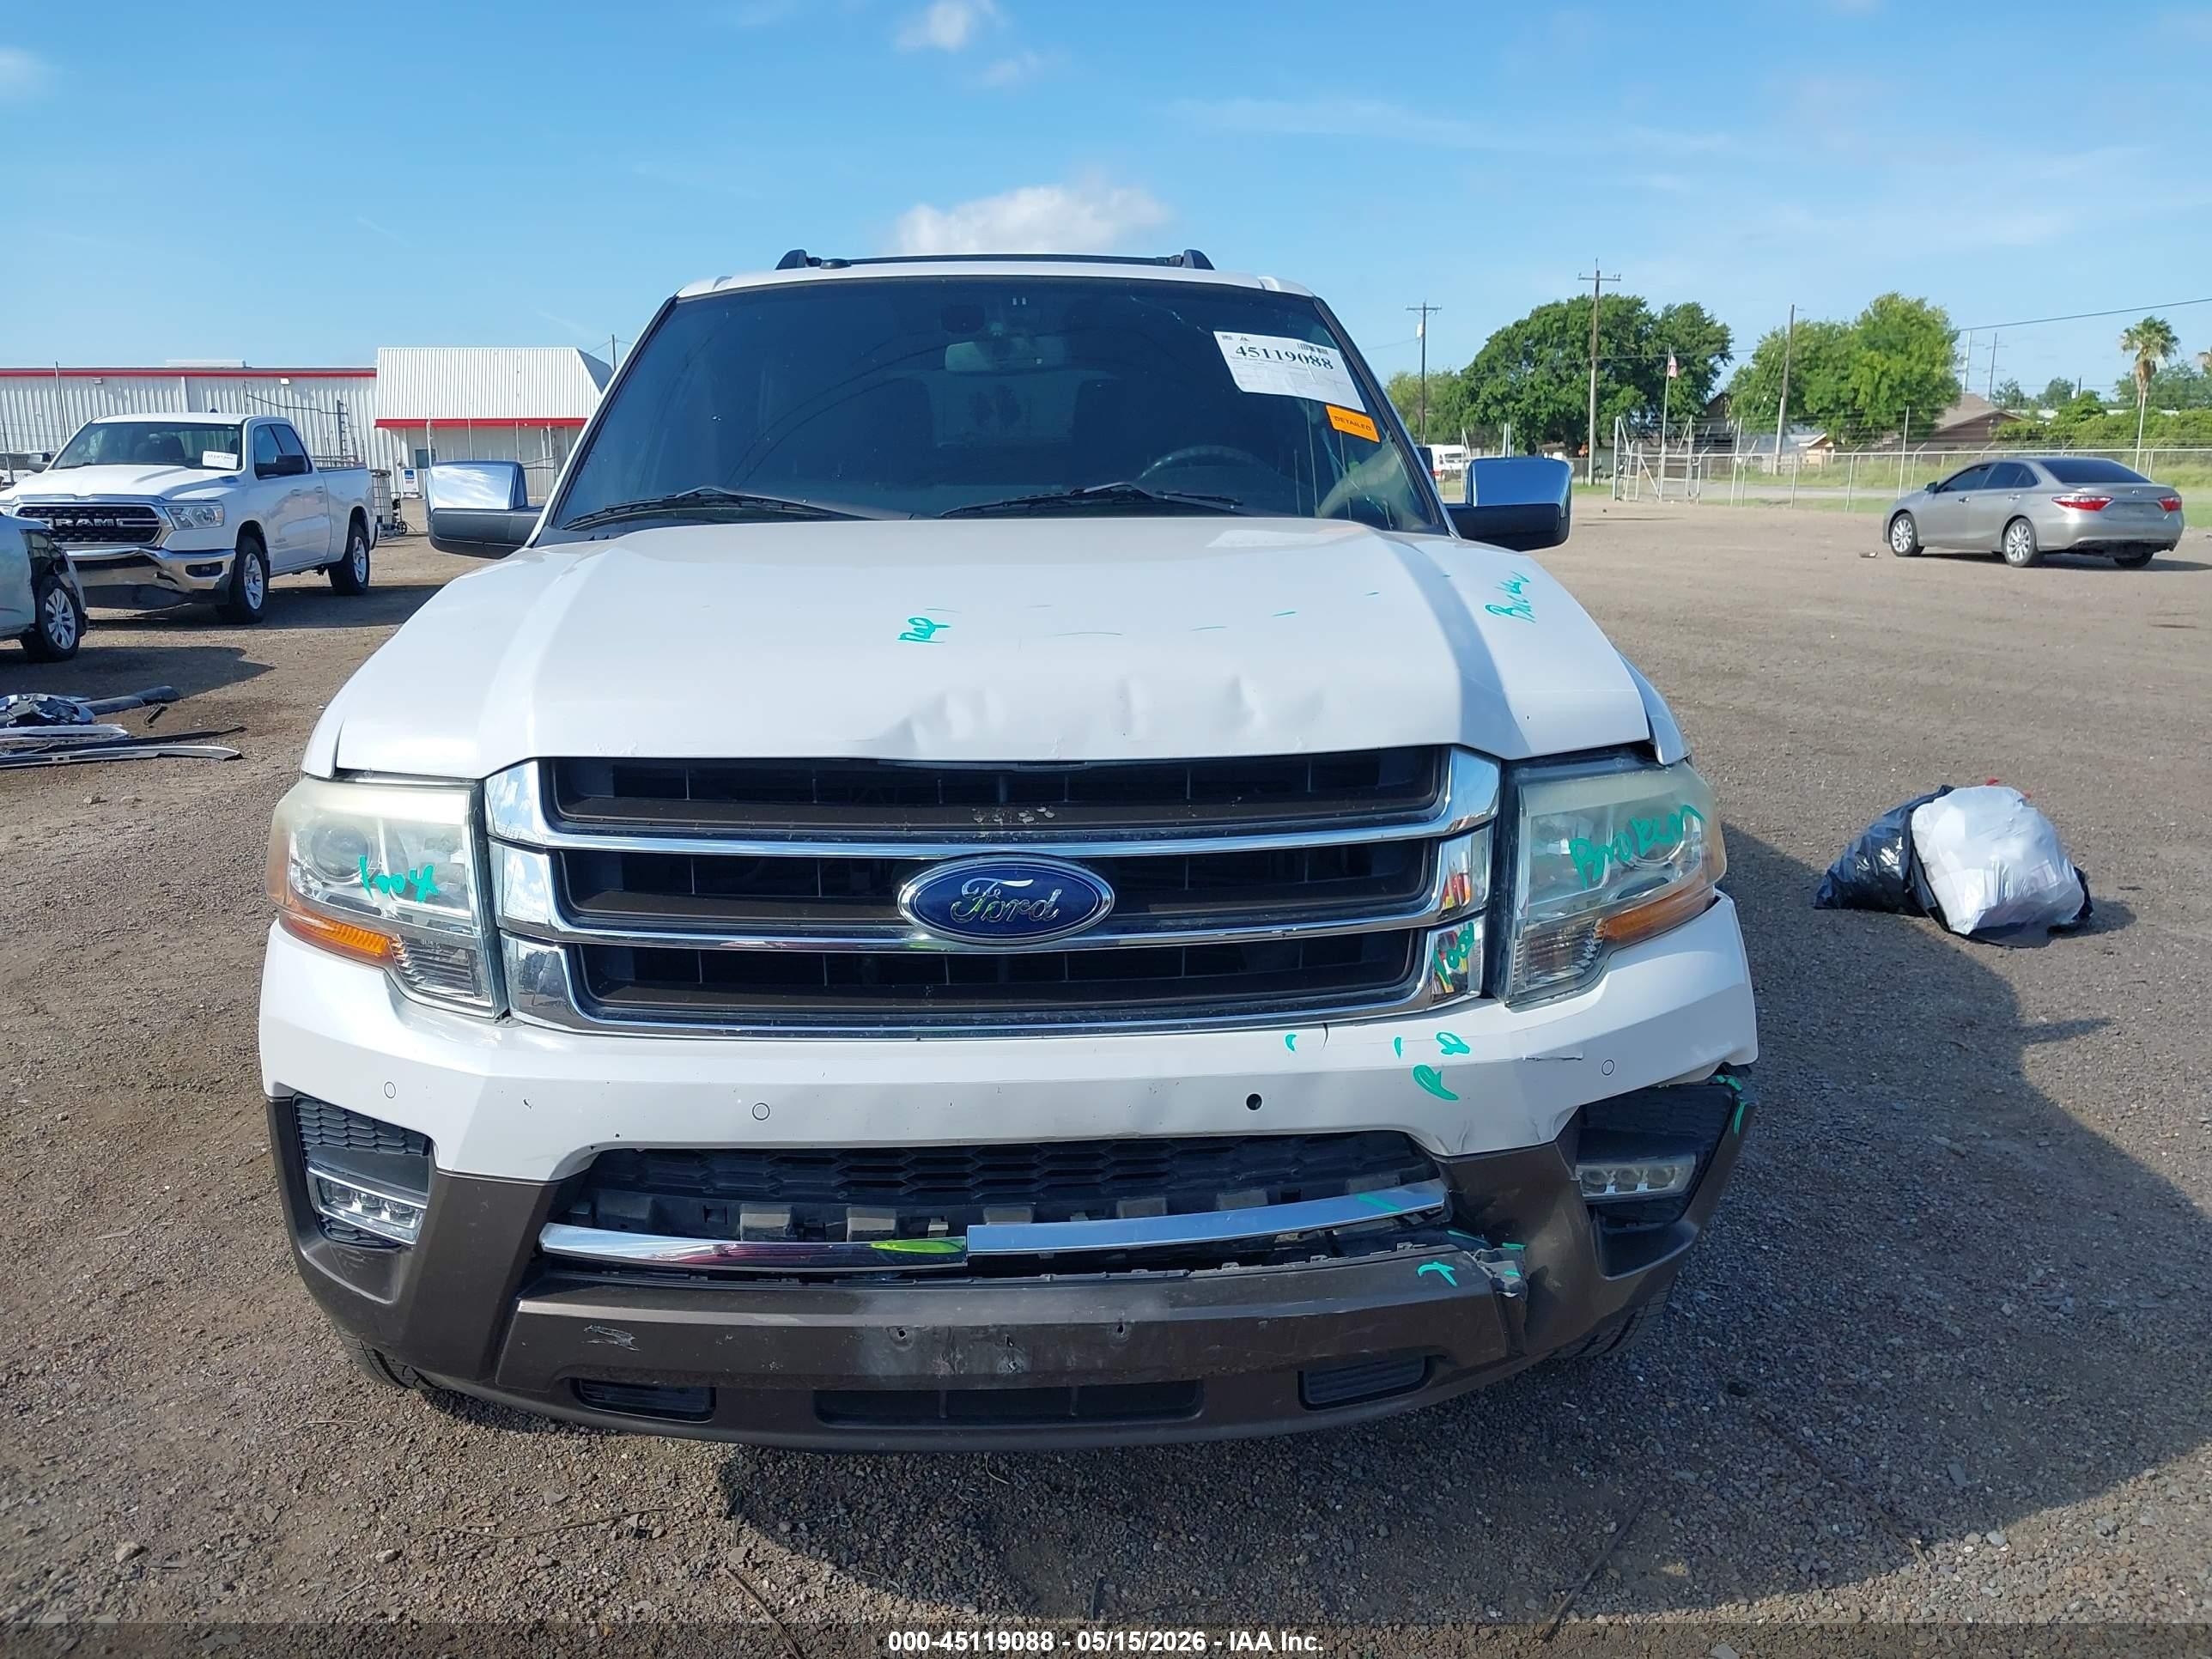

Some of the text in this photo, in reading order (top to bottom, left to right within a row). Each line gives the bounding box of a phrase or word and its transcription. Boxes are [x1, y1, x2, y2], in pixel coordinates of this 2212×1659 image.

[1235, 345, 1334, 370] 45119088
[1334, 416, 1372, 432] DETAILED
[54, 518, 114, 527] RAM
[950, 877, 1063, 924] Ford
